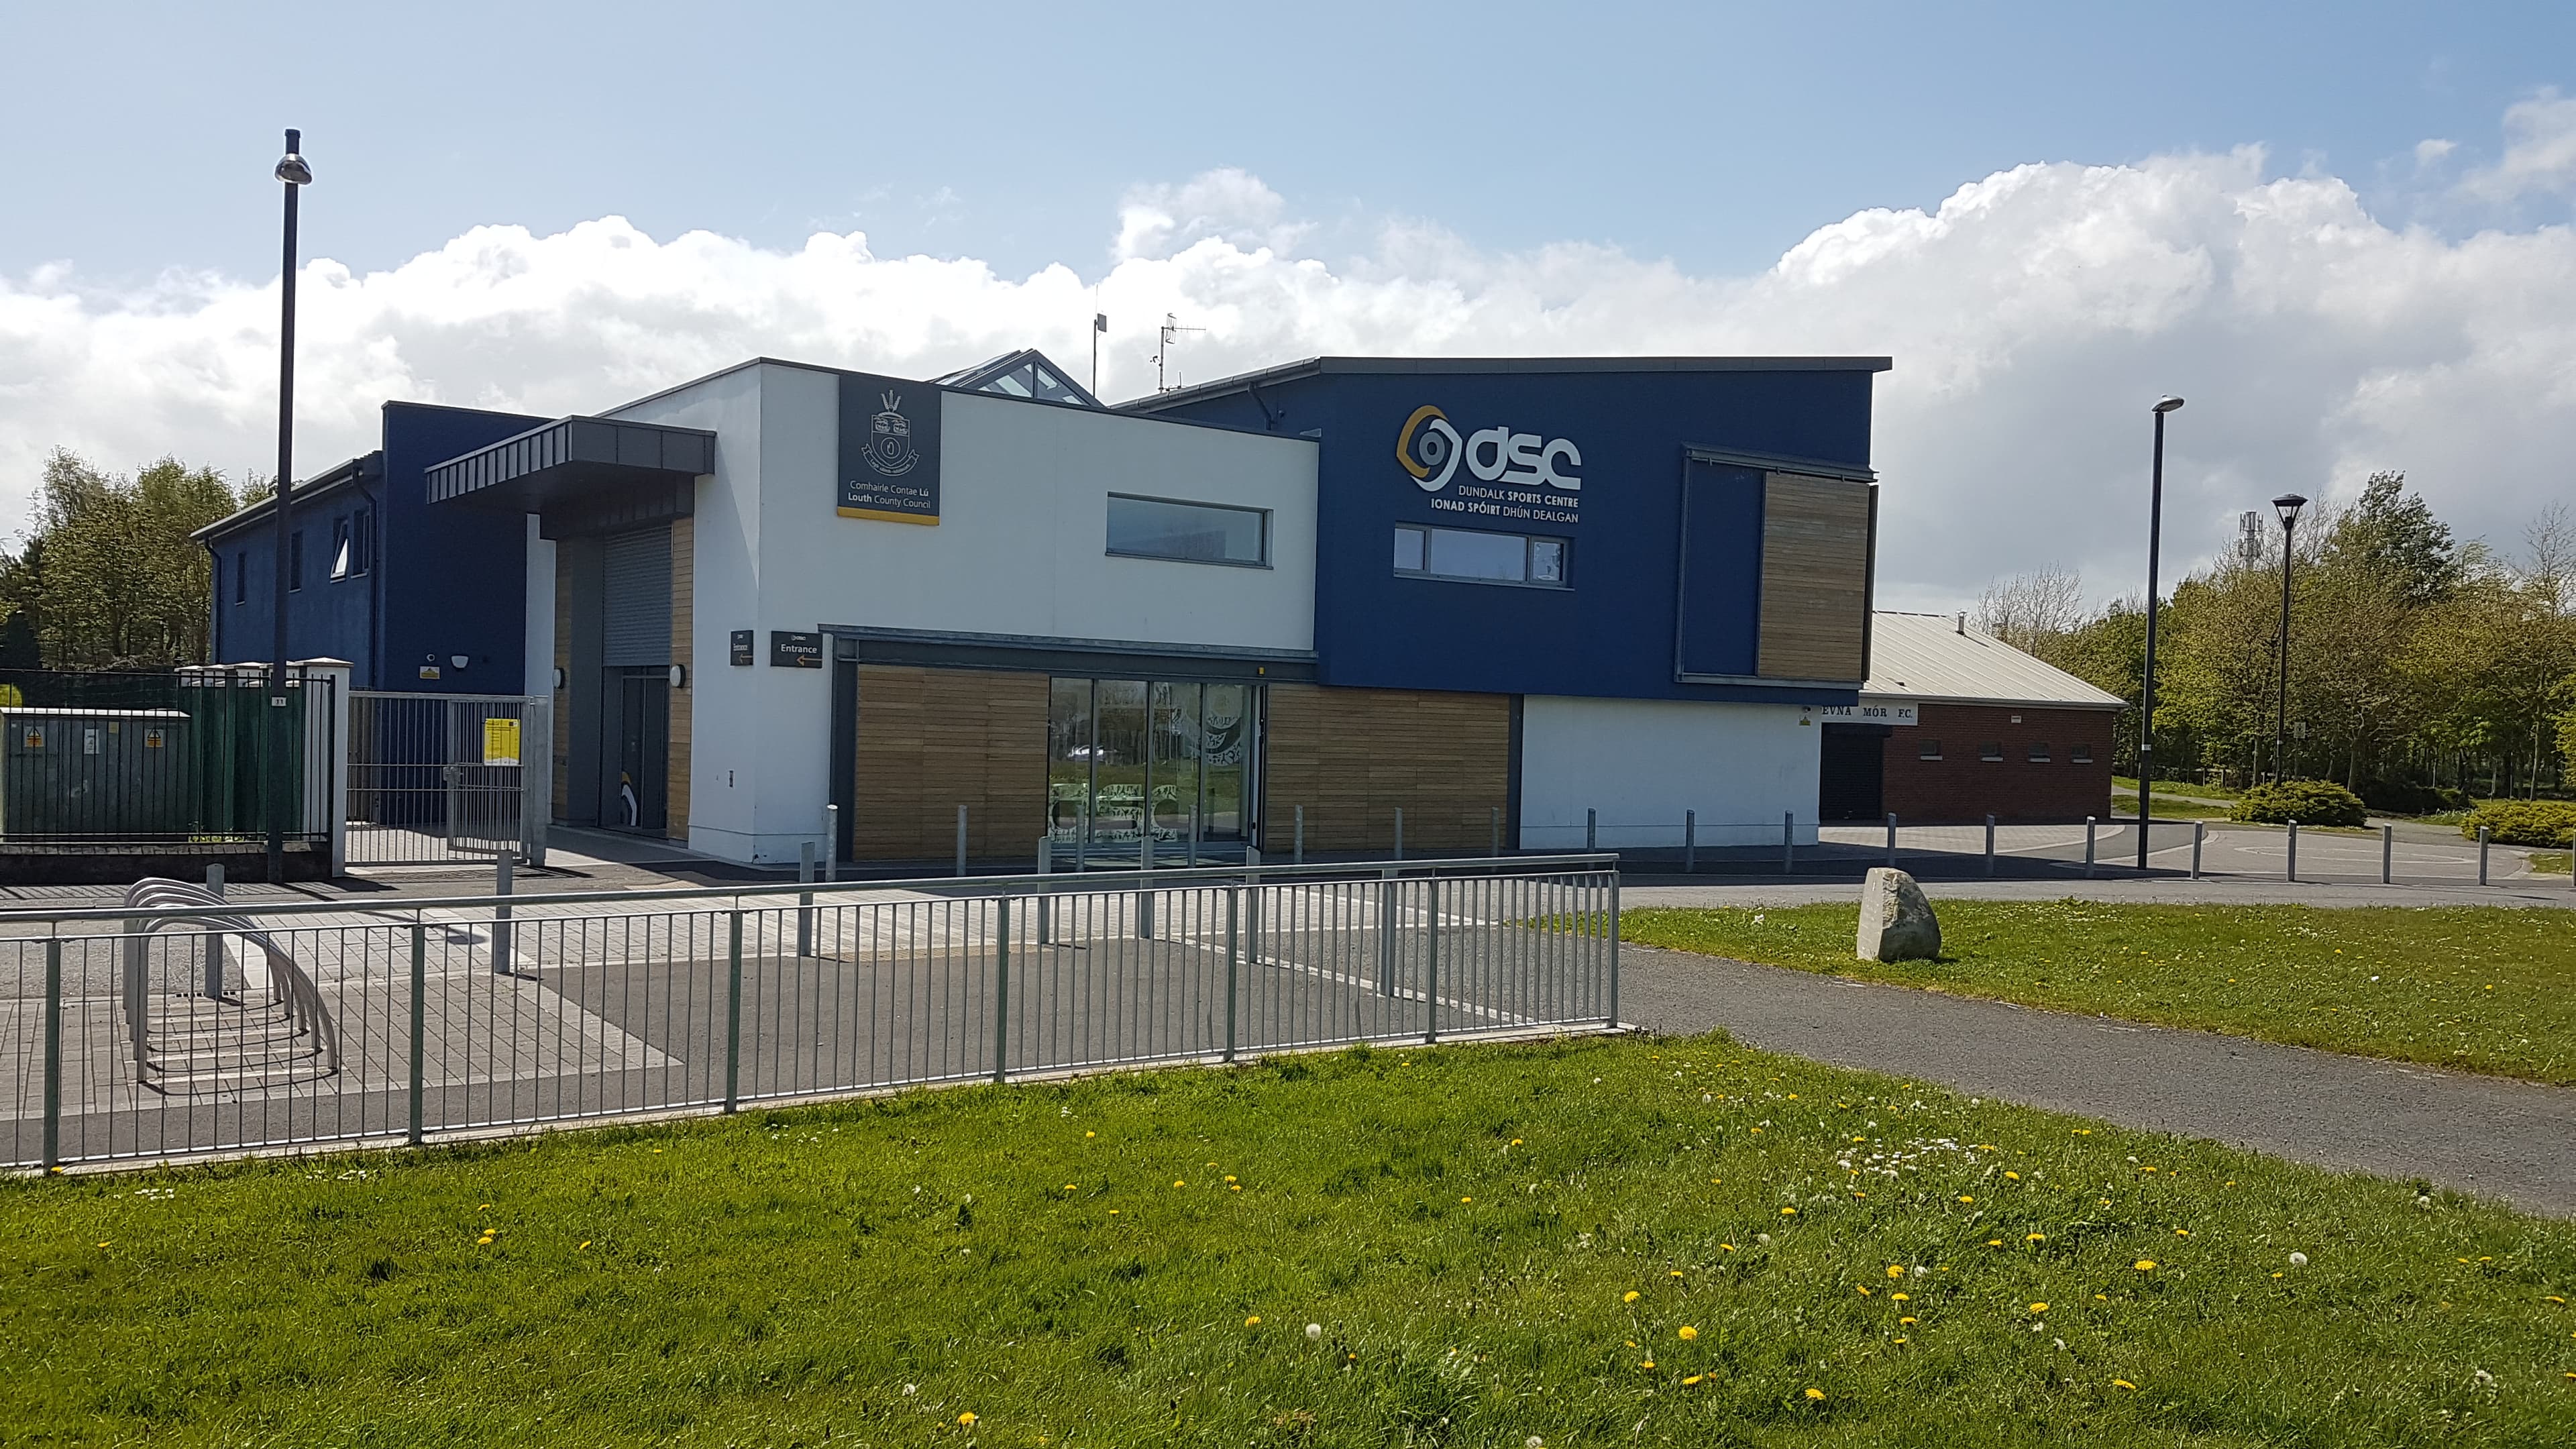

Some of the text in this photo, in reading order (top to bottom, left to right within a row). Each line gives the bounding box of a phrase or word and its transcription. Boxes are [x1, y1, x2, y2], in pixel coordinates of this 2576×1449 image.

[1466, 426, 1581, 490] dsc
[850, 480, 929, 496] Comhairle Contae Lú
[848, 492, 930, 508] Louth County Council
[1458, 485, 1578, 508] DUNDALK SPORTS CENTRE
[1431, 498, 1578, 523] IONAD SPÓIRT DHÚN DEALGAN
[781, 643, 817, 653] Entrance
[1863, 705, 1887, 717] MÓR
